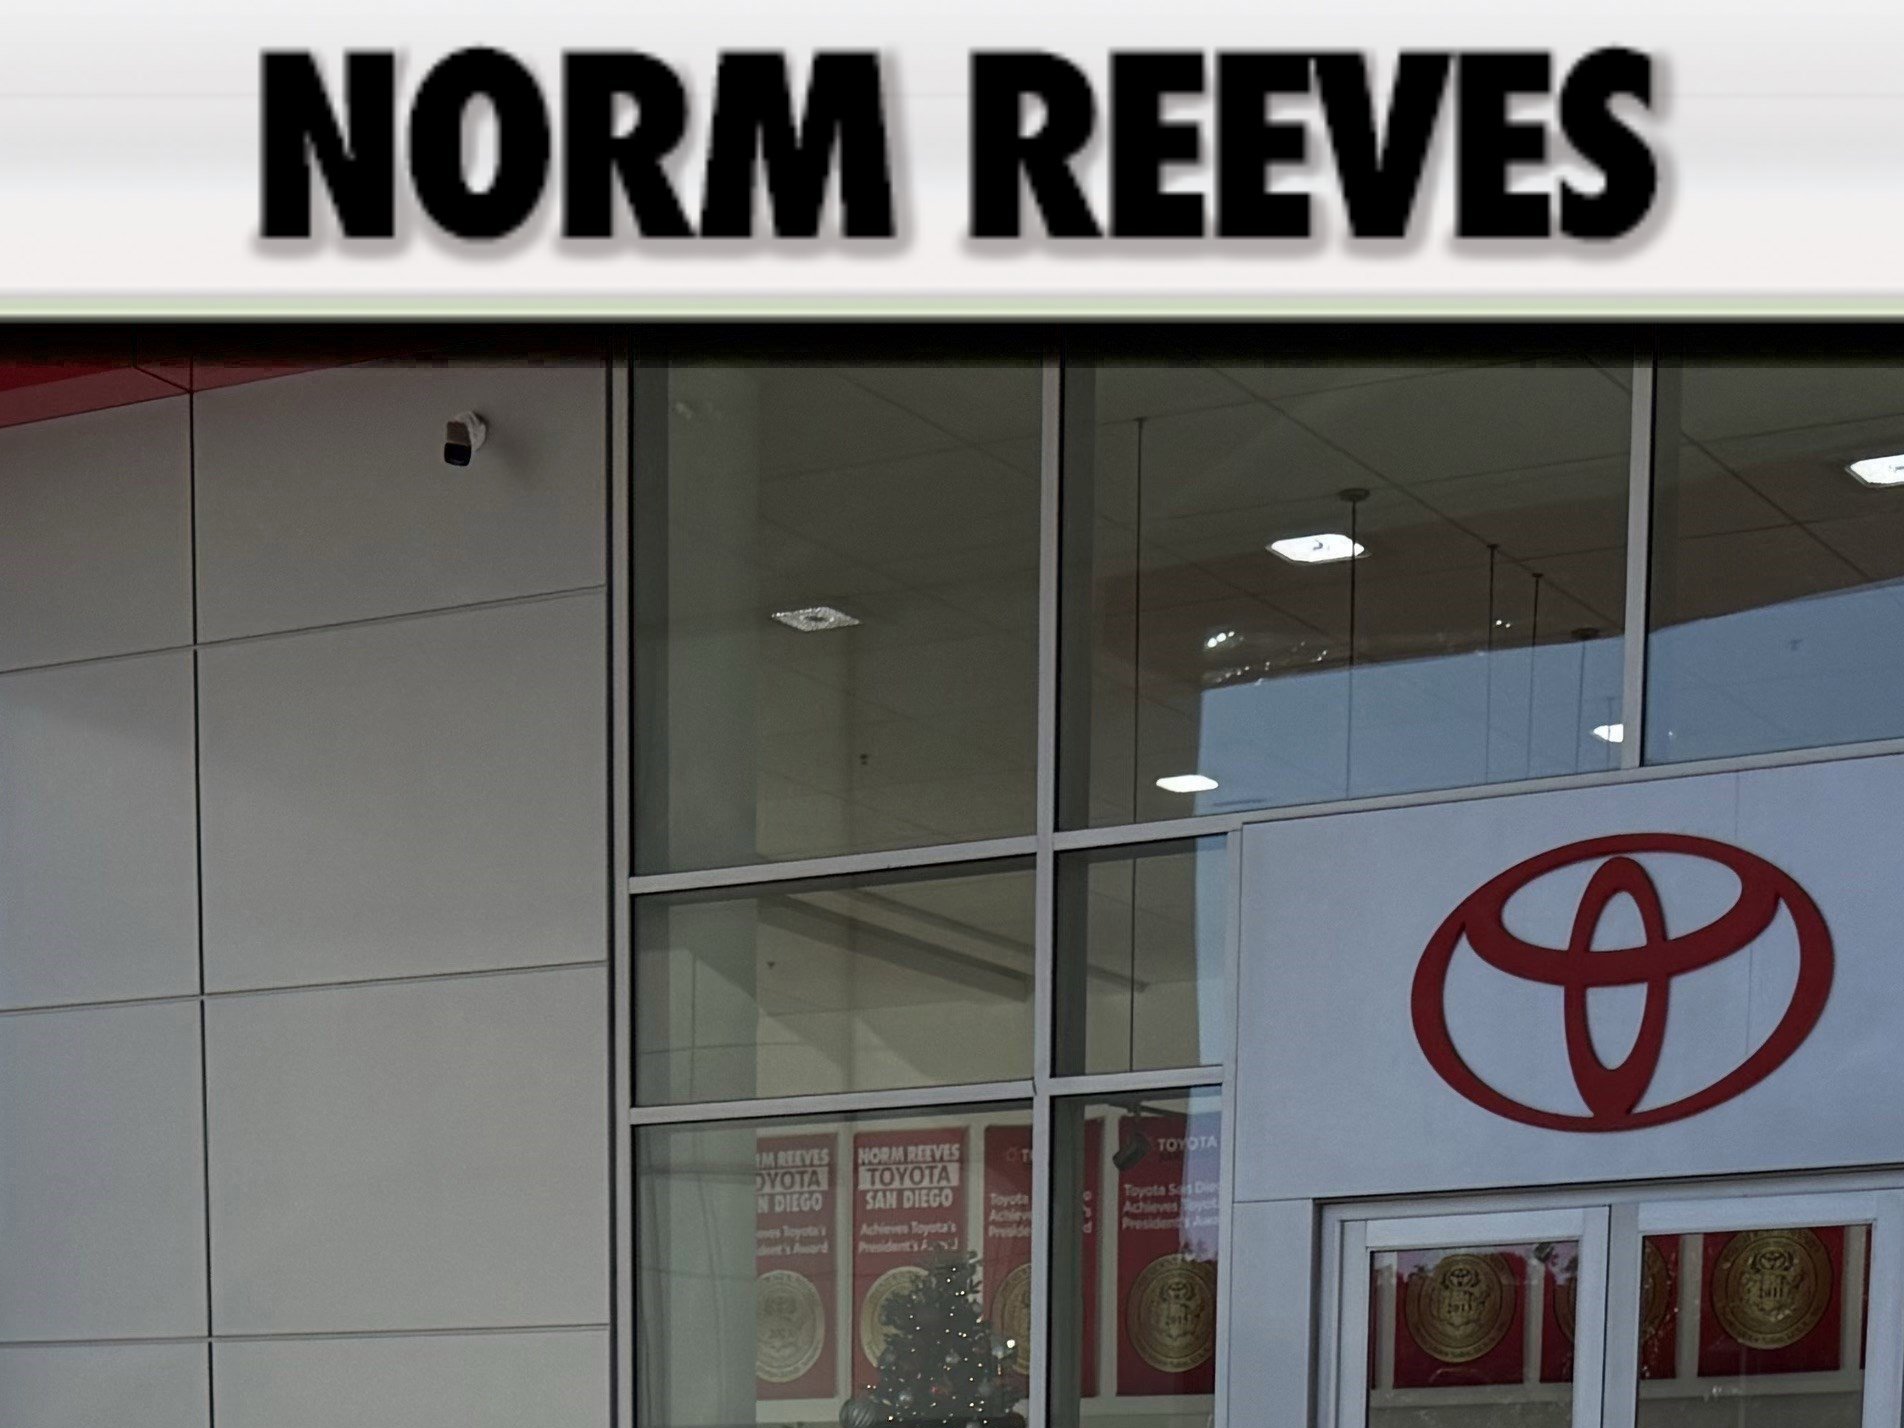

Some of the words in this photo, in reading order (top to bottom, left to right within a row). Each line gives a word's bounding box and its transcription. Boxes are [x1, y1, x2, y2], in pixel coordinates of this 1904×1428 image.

[858, 1146, 904, 1165] NORM
[907, 1143, 960, 1162] REEVES
[1156, 1136, 1218, 1152] TOYOTA
[777, 1148, 830, 1167] REEVES
[755, 1169, 821, 1192] OYOTA
[866, 1165, 951, 1187] TOYOTA
[774, 1193, 823, 1213] DIEGO
[866, 1190, 897, 1210] SAN
[903, 1188, 953, 1208] DIEGO
